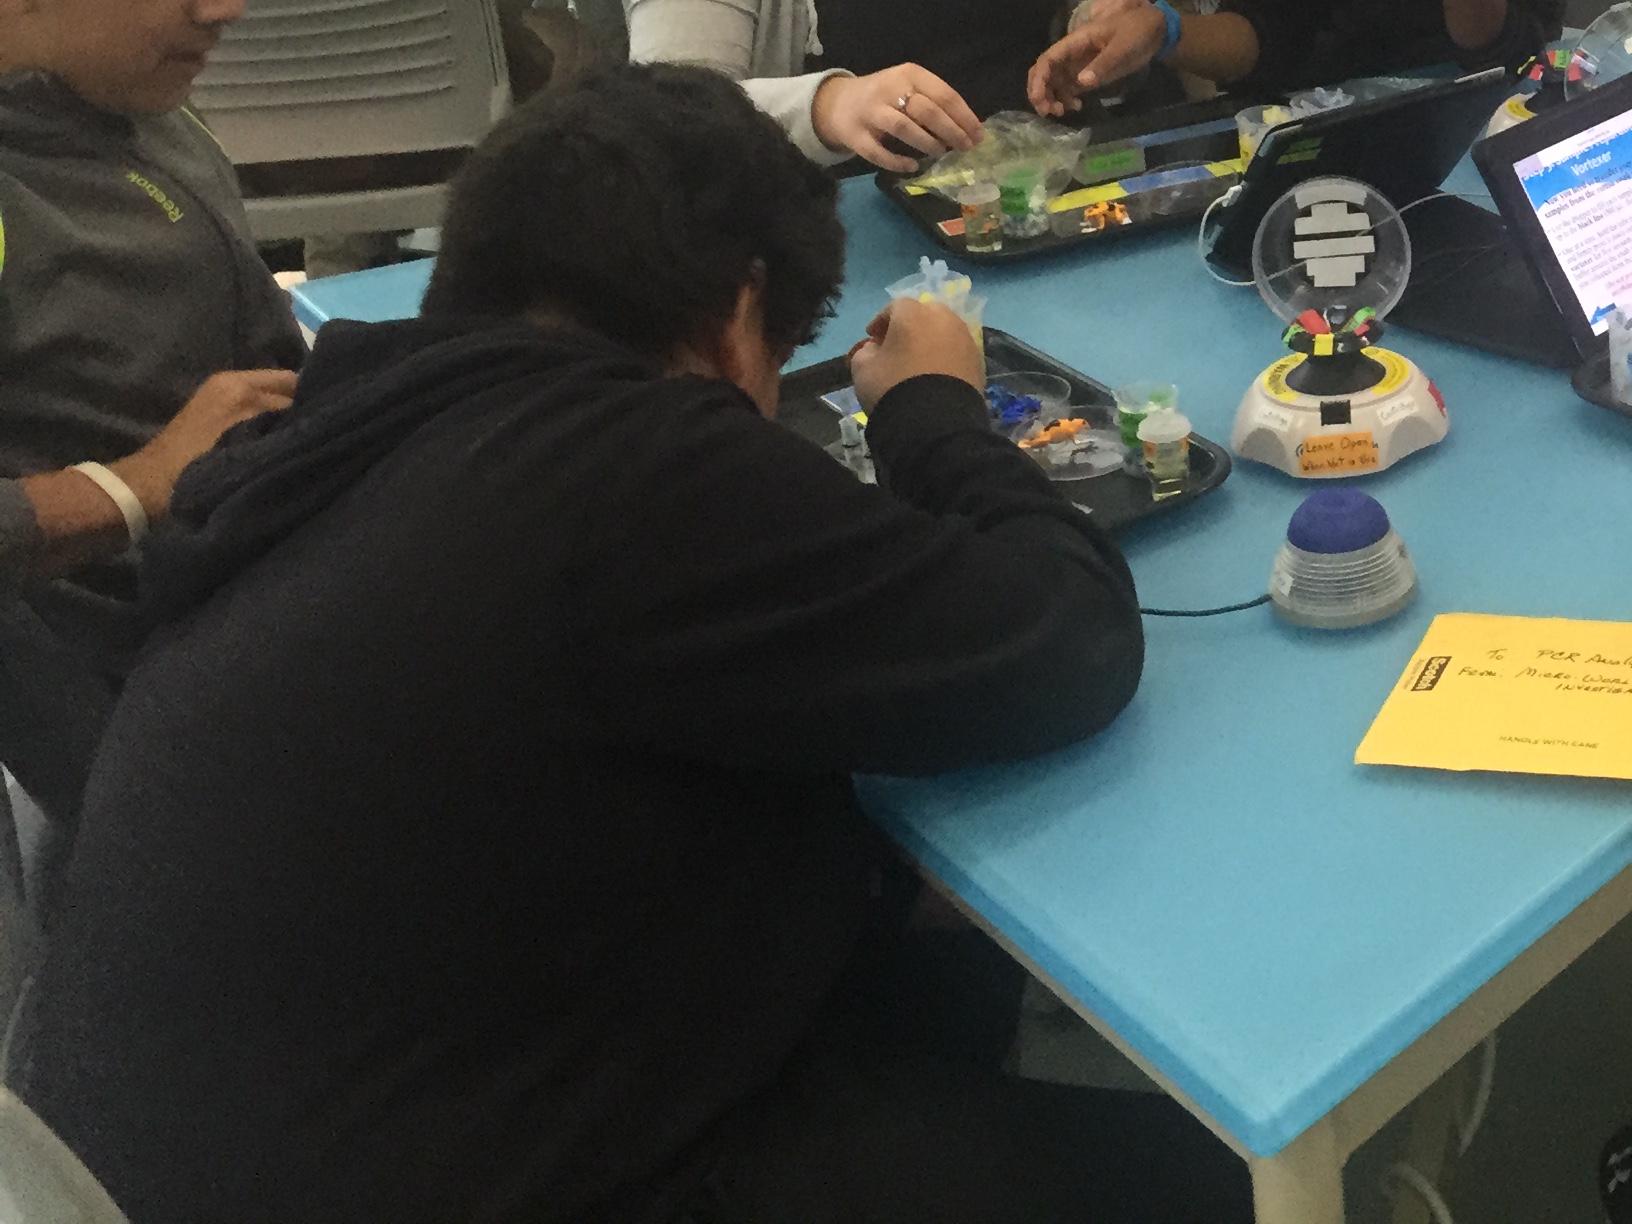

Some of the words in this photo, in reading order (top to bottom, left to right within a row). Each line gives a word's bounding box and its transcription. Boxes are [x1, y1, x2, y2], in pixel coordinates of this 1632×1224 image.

[1570, 151, 1612, 176] Vortexer
[126, 170, 184, 223] Reebok
[1305, 440, 1335, 454] Leave
[1340, 436, 1370, 451] Open
[1486, 648, 1508, 661] To
[1536, 649, 1581, 663] PCR
[1415, 657, 1448, 691] Scotch
[1542, 738, 1570, 748] WITH
